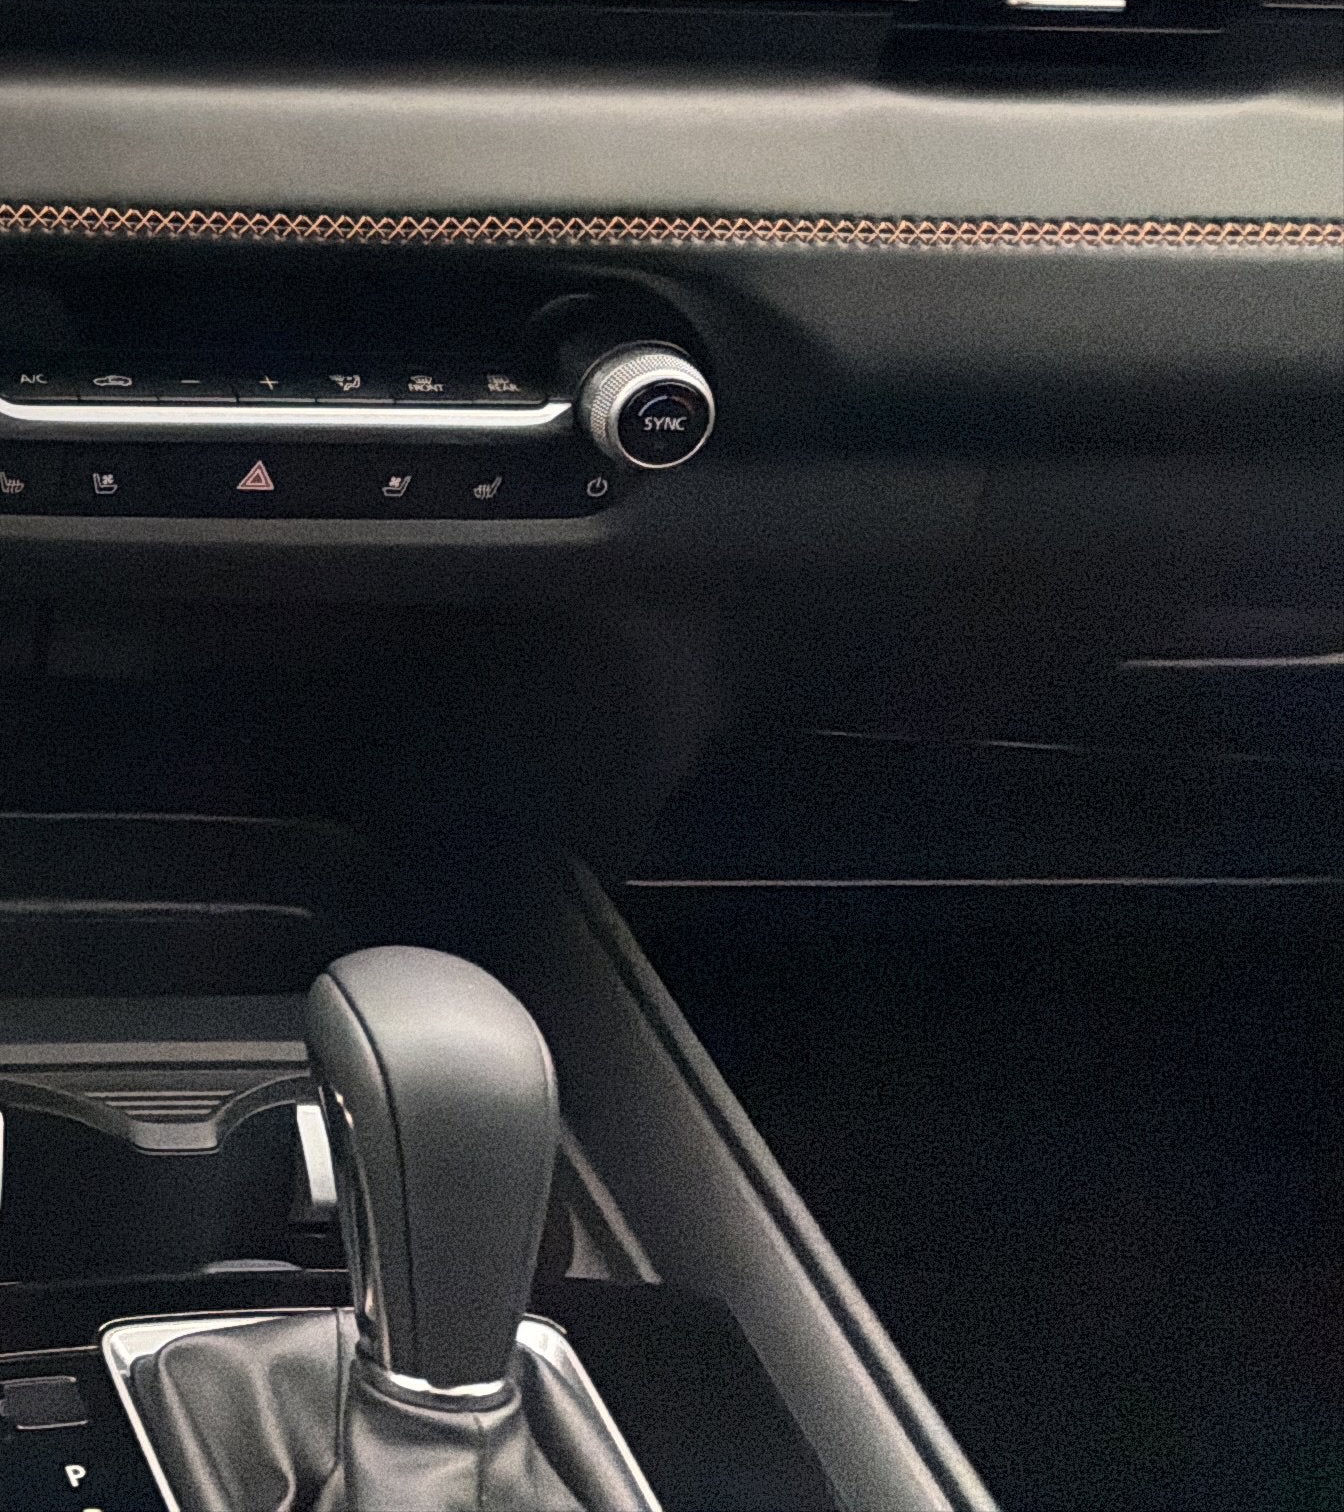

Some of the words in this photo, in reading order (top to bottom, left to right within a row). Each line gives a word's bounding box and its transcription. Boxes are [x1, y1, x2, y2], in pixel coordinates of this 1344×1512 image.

[19, 373, 49, 385] A/C
[642, 416, 687, 431] SYNC
[64, 1464, 87, 1488] P
